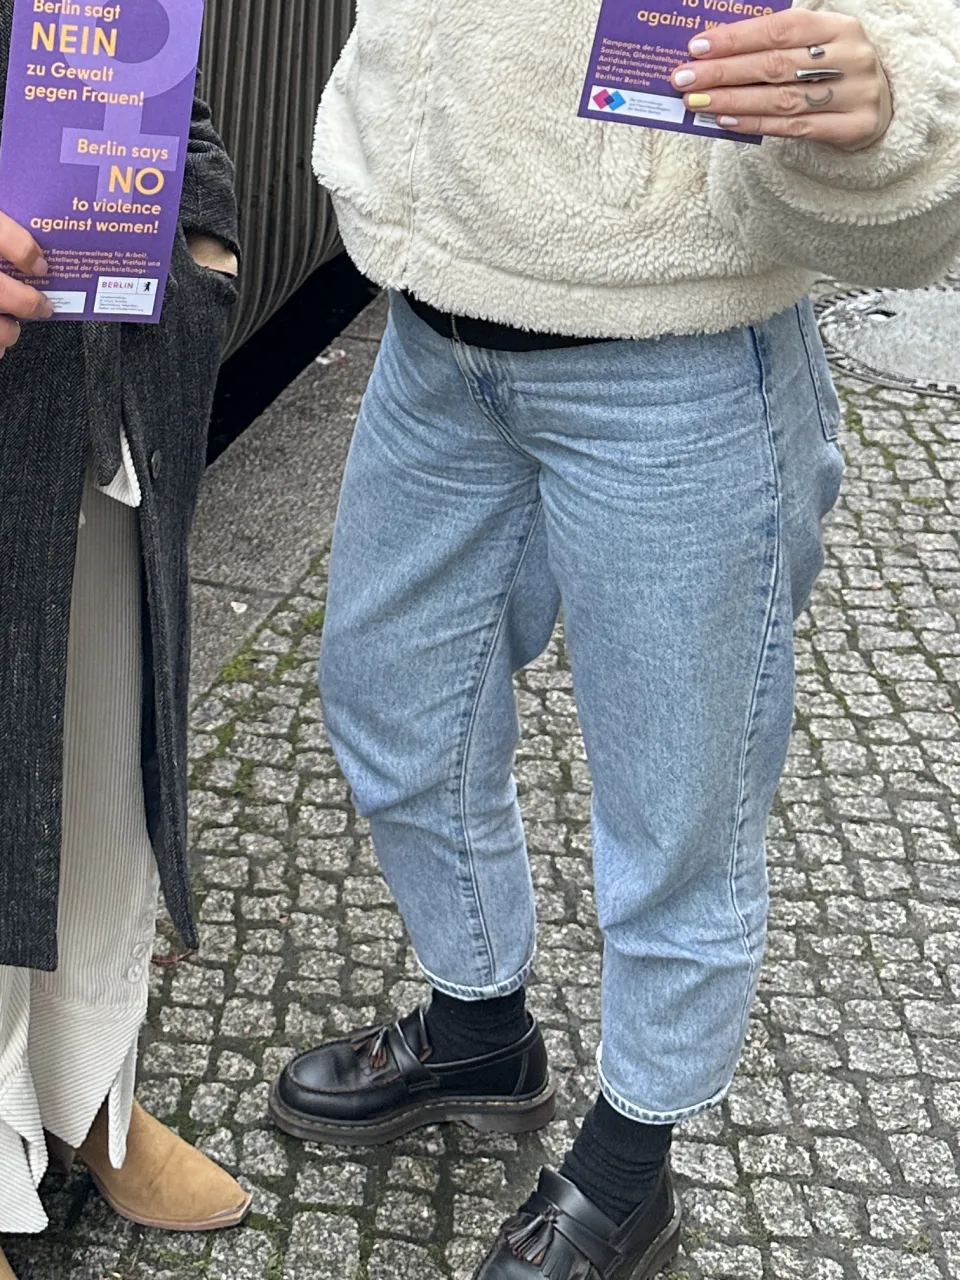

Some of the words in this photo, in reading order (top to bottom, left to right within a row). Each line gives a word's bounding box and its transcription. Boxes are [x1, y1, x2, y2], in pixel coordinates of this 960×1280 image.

[85, 5, 121, 22] sagt
[637, 10, 700, 29] against
[31, 22, 118, 57] NEIN
[602, 38, 640, 49] Kampagne
[642, 43, 654, 51] der
[599, 56, 667, 72] Antidiskriminierung
[601, 47, 631, 58] Soziales,
[633, 51, 685, 65] Gleichstellung,
[26, 64, 45, 76] zu
[51, 62, 114, 82] Gewalt
[597, 64, 610, 72] und
[595, 72, 623, 82] Berliner
[624, 77, 651, 86] Bezirke
[24, 84, 77, 102] gegen
[82, 87, 144, 106] Frauen!
[77, 138, 126, 157] Berlin
[132, 146, 169, 162] says
[108, 165, 165, 195] NO
[72, 197, 88, 211] to
[93, 198, 161, 215] violence
[30, 216, 92, 232] against
[96, 220, 159, 234] women!
[101, 281, 134, 289] BERLIN
